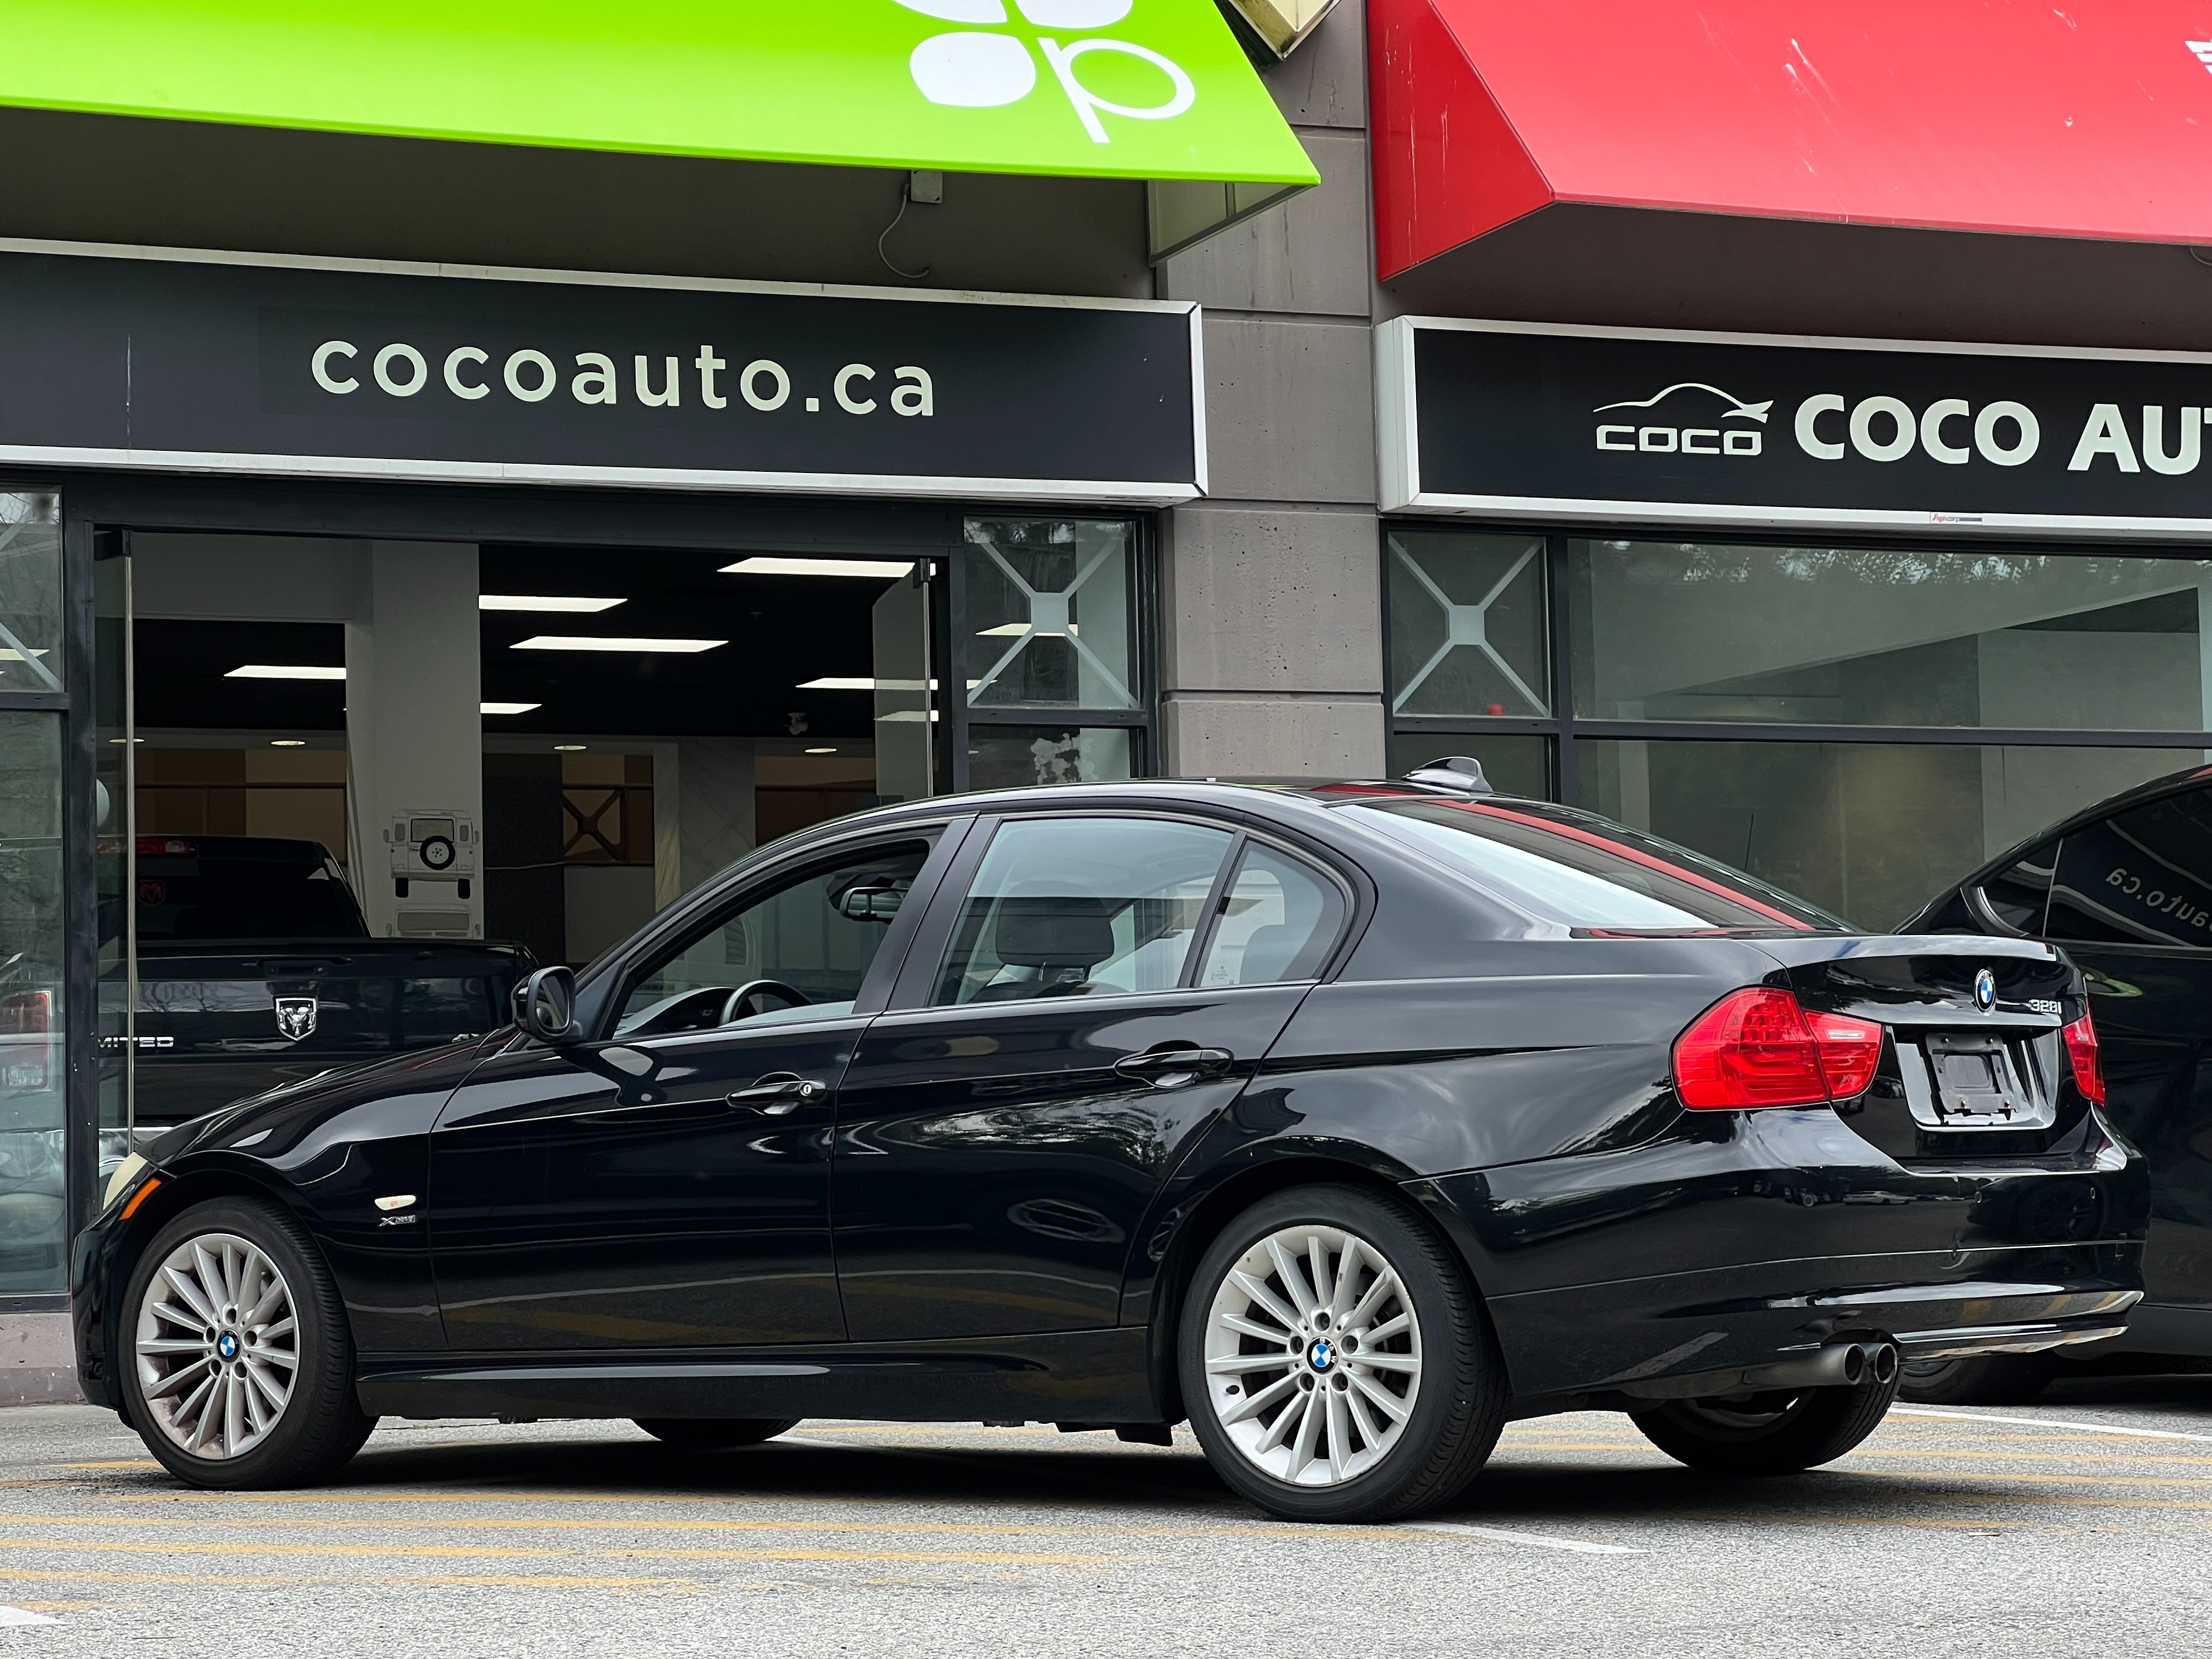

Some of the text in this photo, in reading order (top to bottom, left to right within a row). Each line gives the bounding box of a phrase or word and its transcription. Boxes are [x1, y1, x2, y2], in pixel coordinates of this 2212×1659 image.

[311, 339, 934, 416] cocoauto.ca
[1596, 424, 1762, 456] COCO
[1794, 393, 2040, 466] COCO
